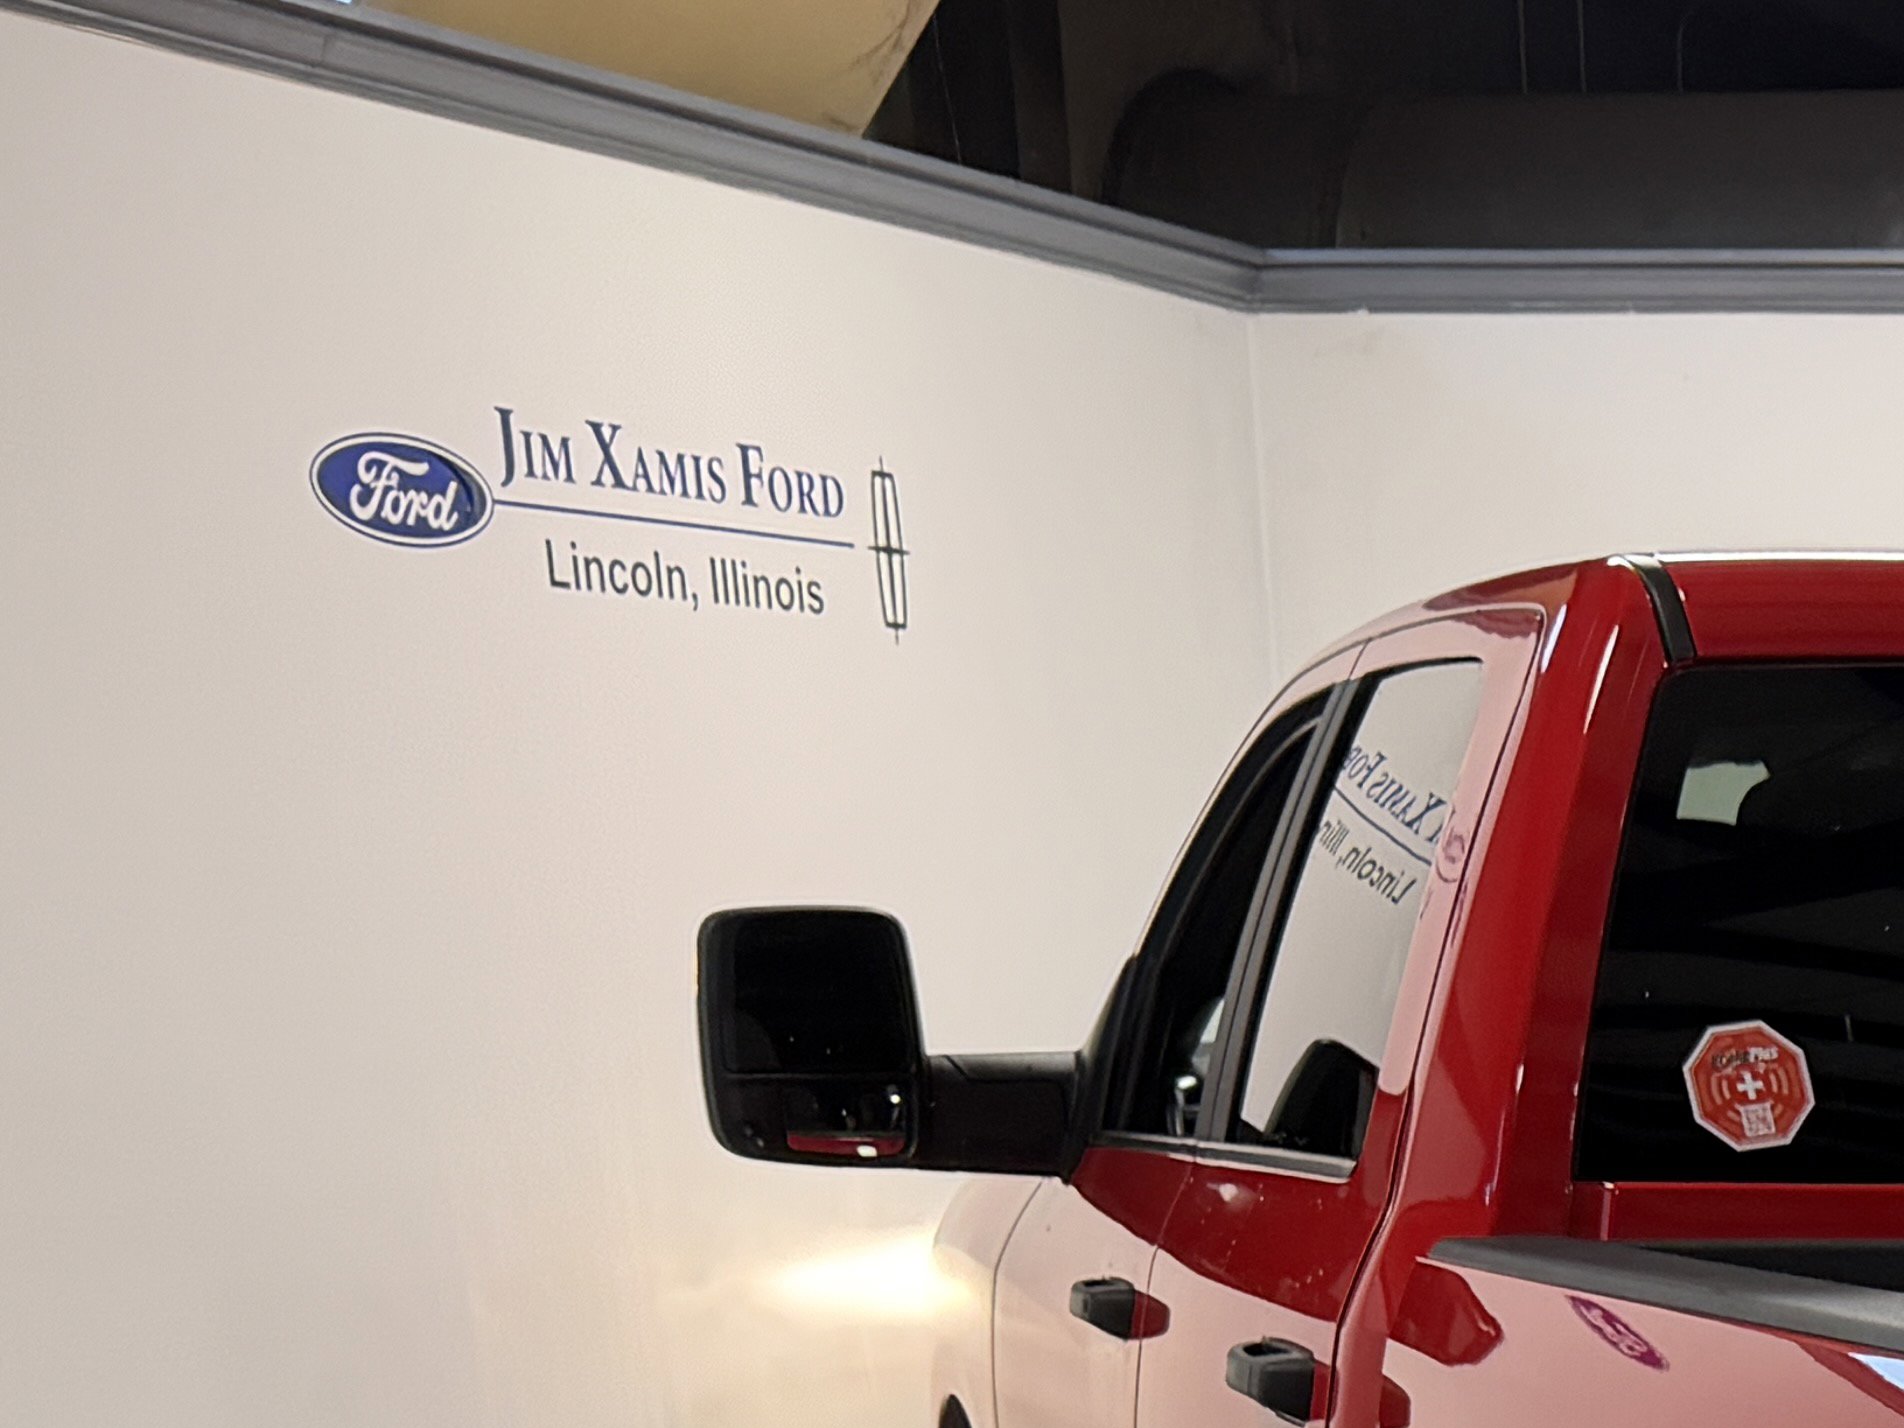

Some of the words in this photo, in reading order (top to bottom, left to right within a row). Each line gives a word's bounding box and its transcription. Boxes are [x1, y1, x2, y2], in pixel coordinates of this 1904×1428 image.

[349, 450, 460, 532] Ford
[494, 406, 576, 488] JIM
[584, 420, 728, 504] XAMIS
[736, 442, 845, 518] FORD
[544, 539, 699, 612] Lincoln,
[709, 557, 825, 615] Illinois
